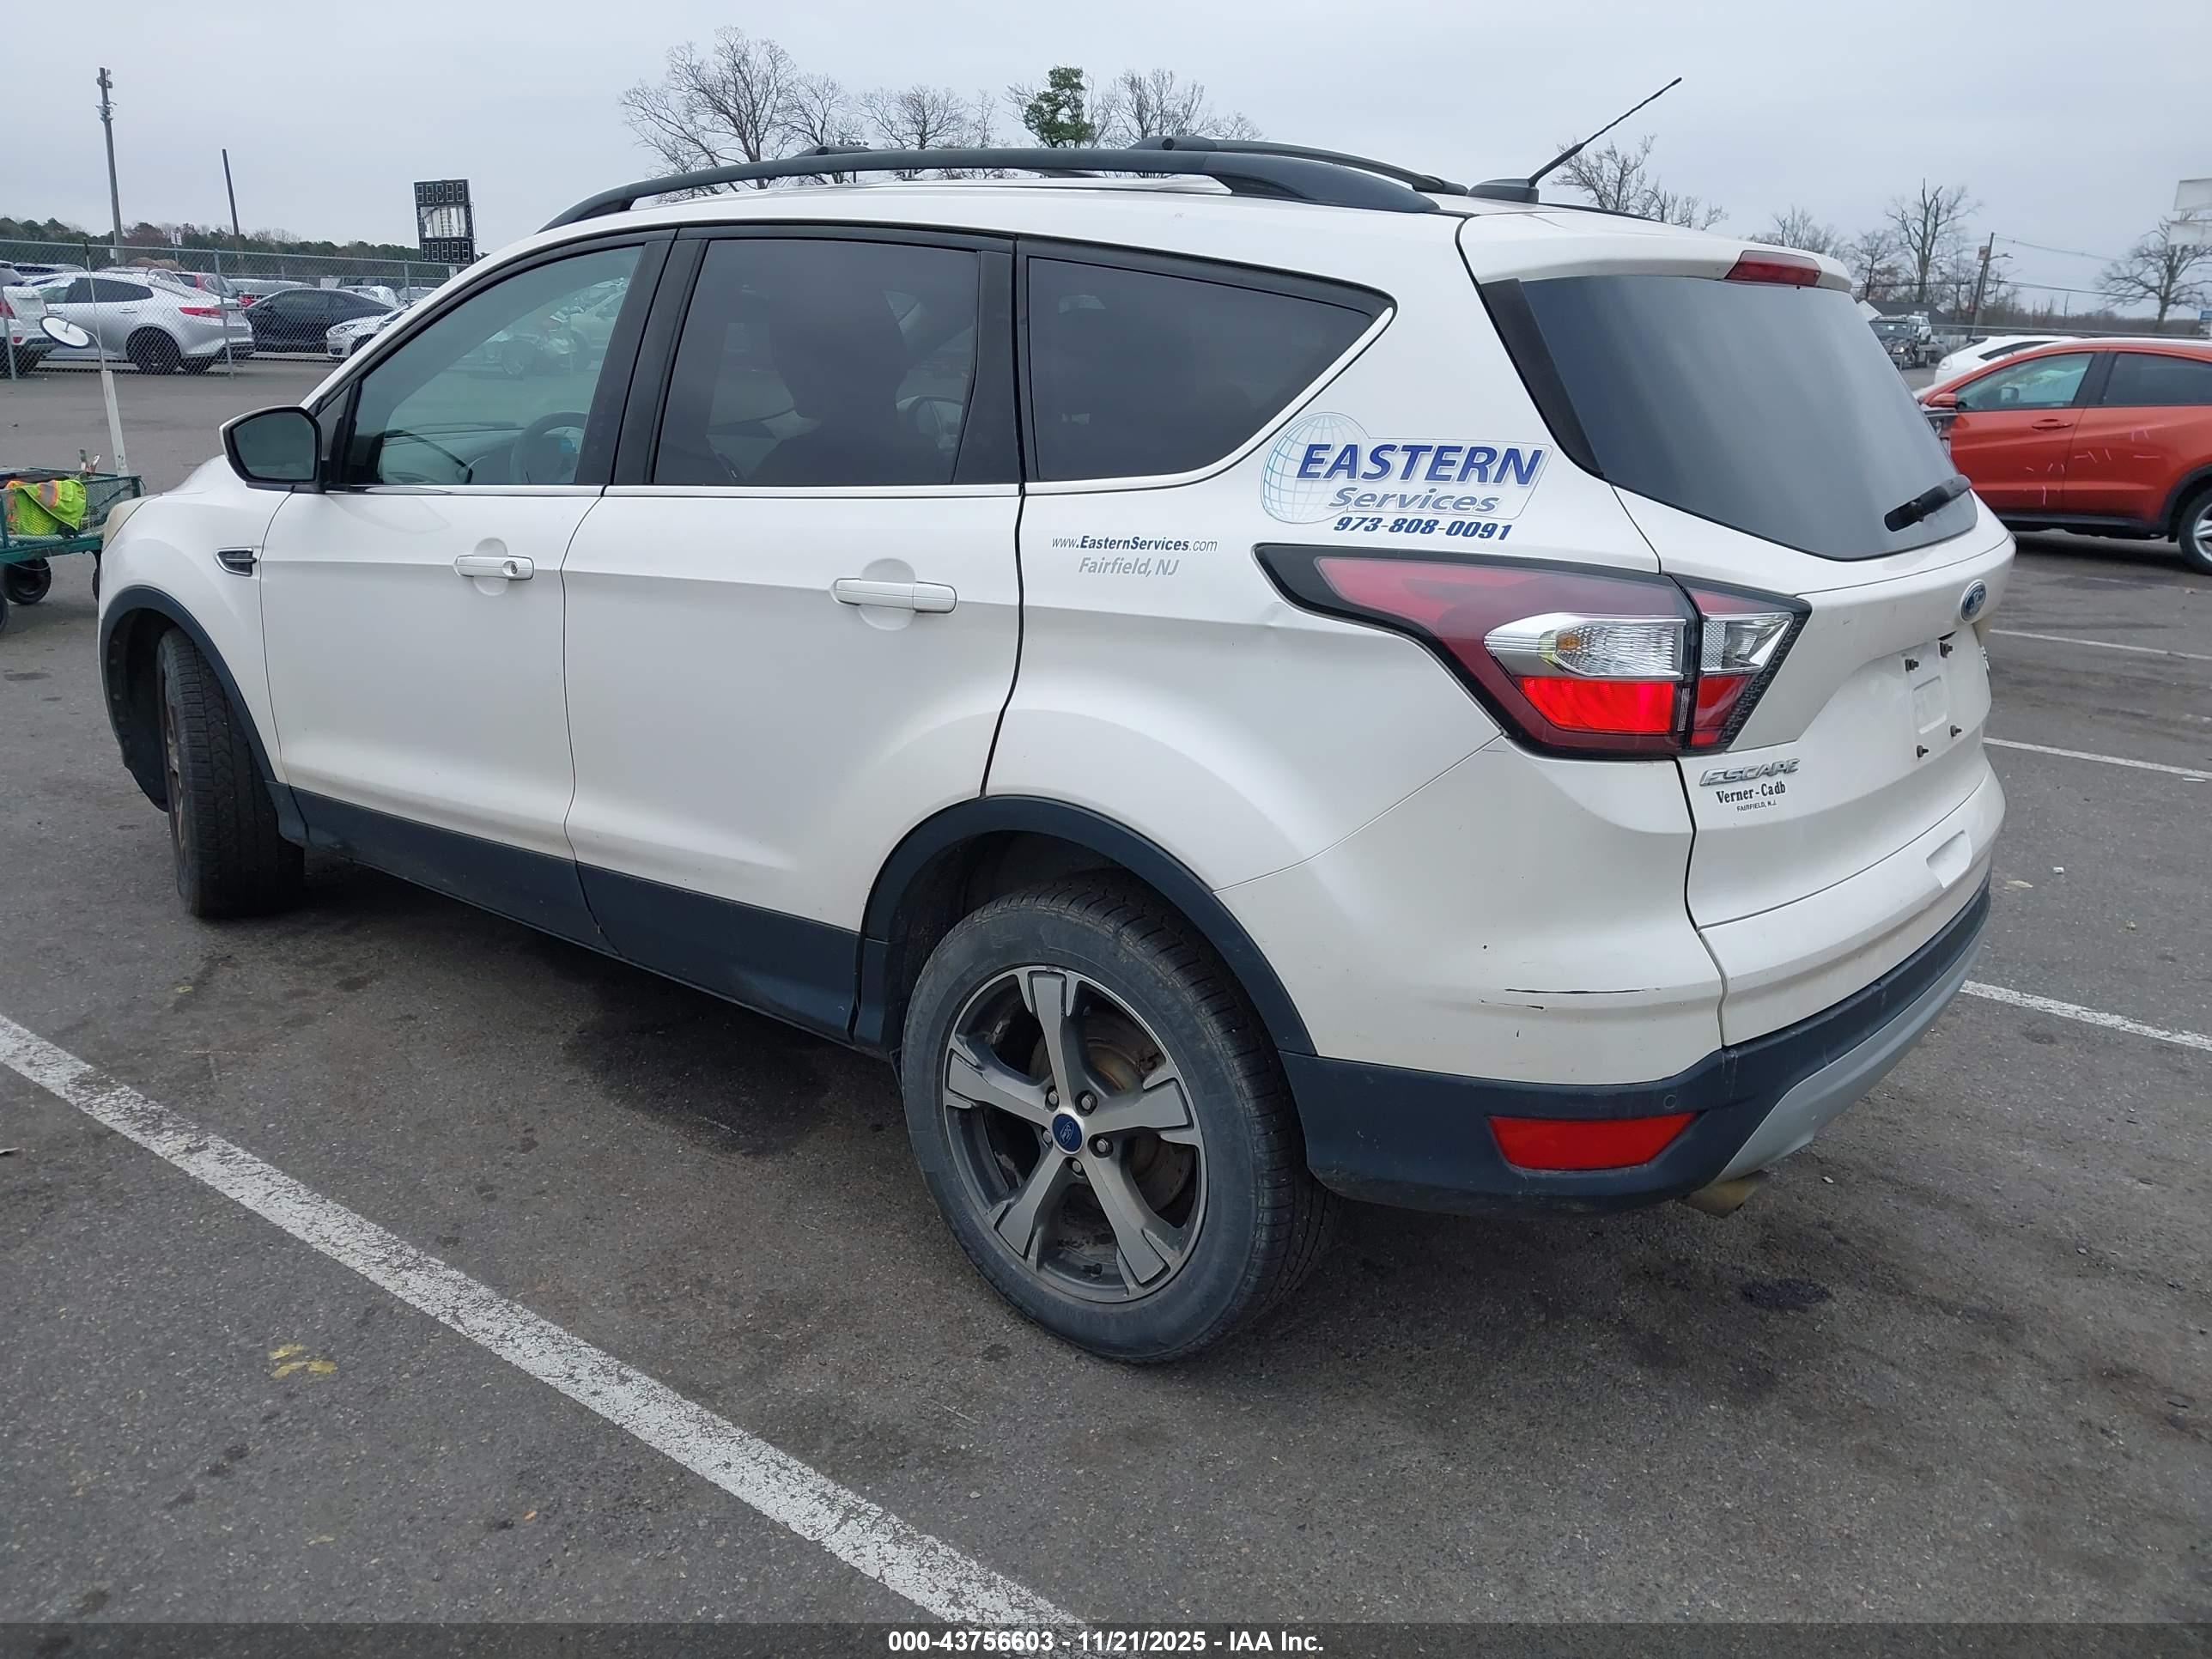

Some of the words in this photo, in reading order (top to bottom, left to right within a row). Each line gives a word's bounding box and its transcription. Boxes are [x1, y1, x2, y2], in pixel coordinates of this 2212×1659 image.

[1297, 444, 1542, 485] EASTERN
[1329, 487, 1499, 512] Services
[1334, 517, 1512, 540] 973-808-0091
[1052, 536, 1218, 551] www.EasternServices.com
[1079, 557, 1152, 577] Fairfield,
[1155, 559, 1179, 575] NJ
[1699, 758, 1800, 787] ESCAPE
